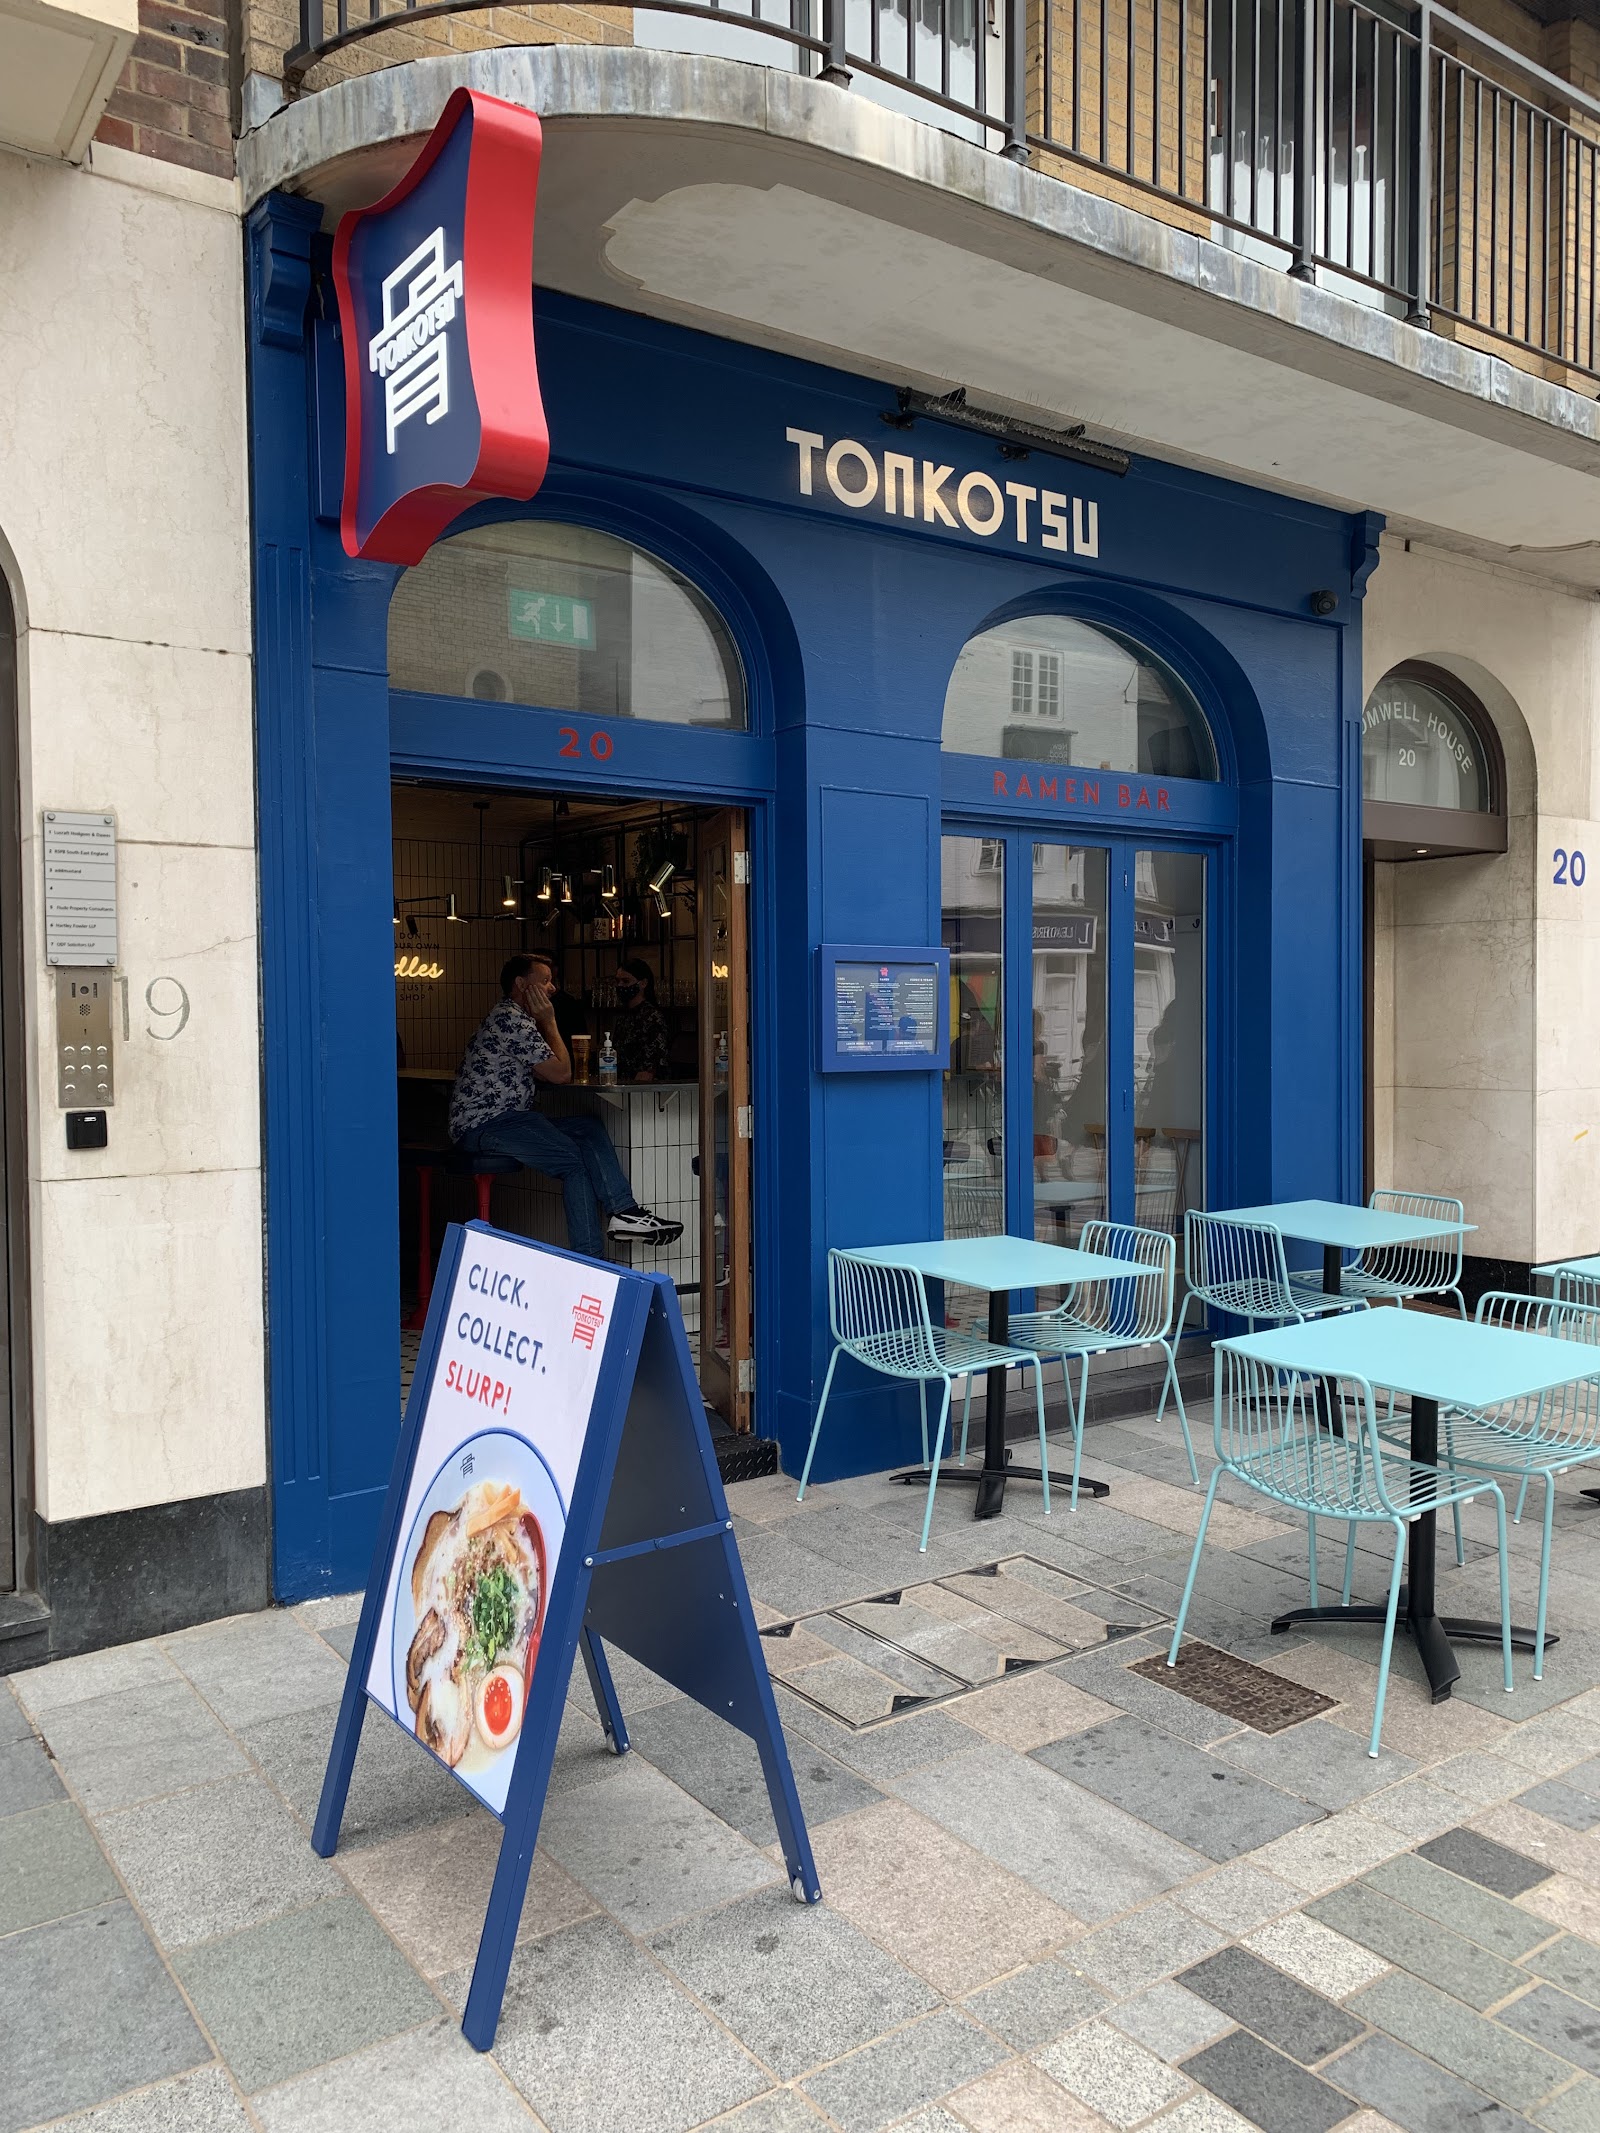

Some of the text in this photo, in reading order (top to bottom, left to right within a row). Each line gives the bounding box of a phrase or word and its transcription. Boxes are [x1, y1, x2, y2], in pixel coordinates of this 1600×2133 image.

[377, 287, 456, 378] TONKOTSU
[786, 426, 1098, 558] TONKOTSU
[559, 727, 613, 761] 20
[1398, 748, 1416, 766] 20
[1427, 712, 1473, 774] HOUSE
[993, 770, 1170, 811] RAMEN BAR
[1553, 848, 1586, 887] 20
[114, 975, 191, 1042] 19
[400, 993, 426, 1001] SHOP
[468, 1263, 529, 1310] CLICK.
[457, 1312, 546, 1375] COLLECT.
[445, 1360, 512, 1415] SLURP!
